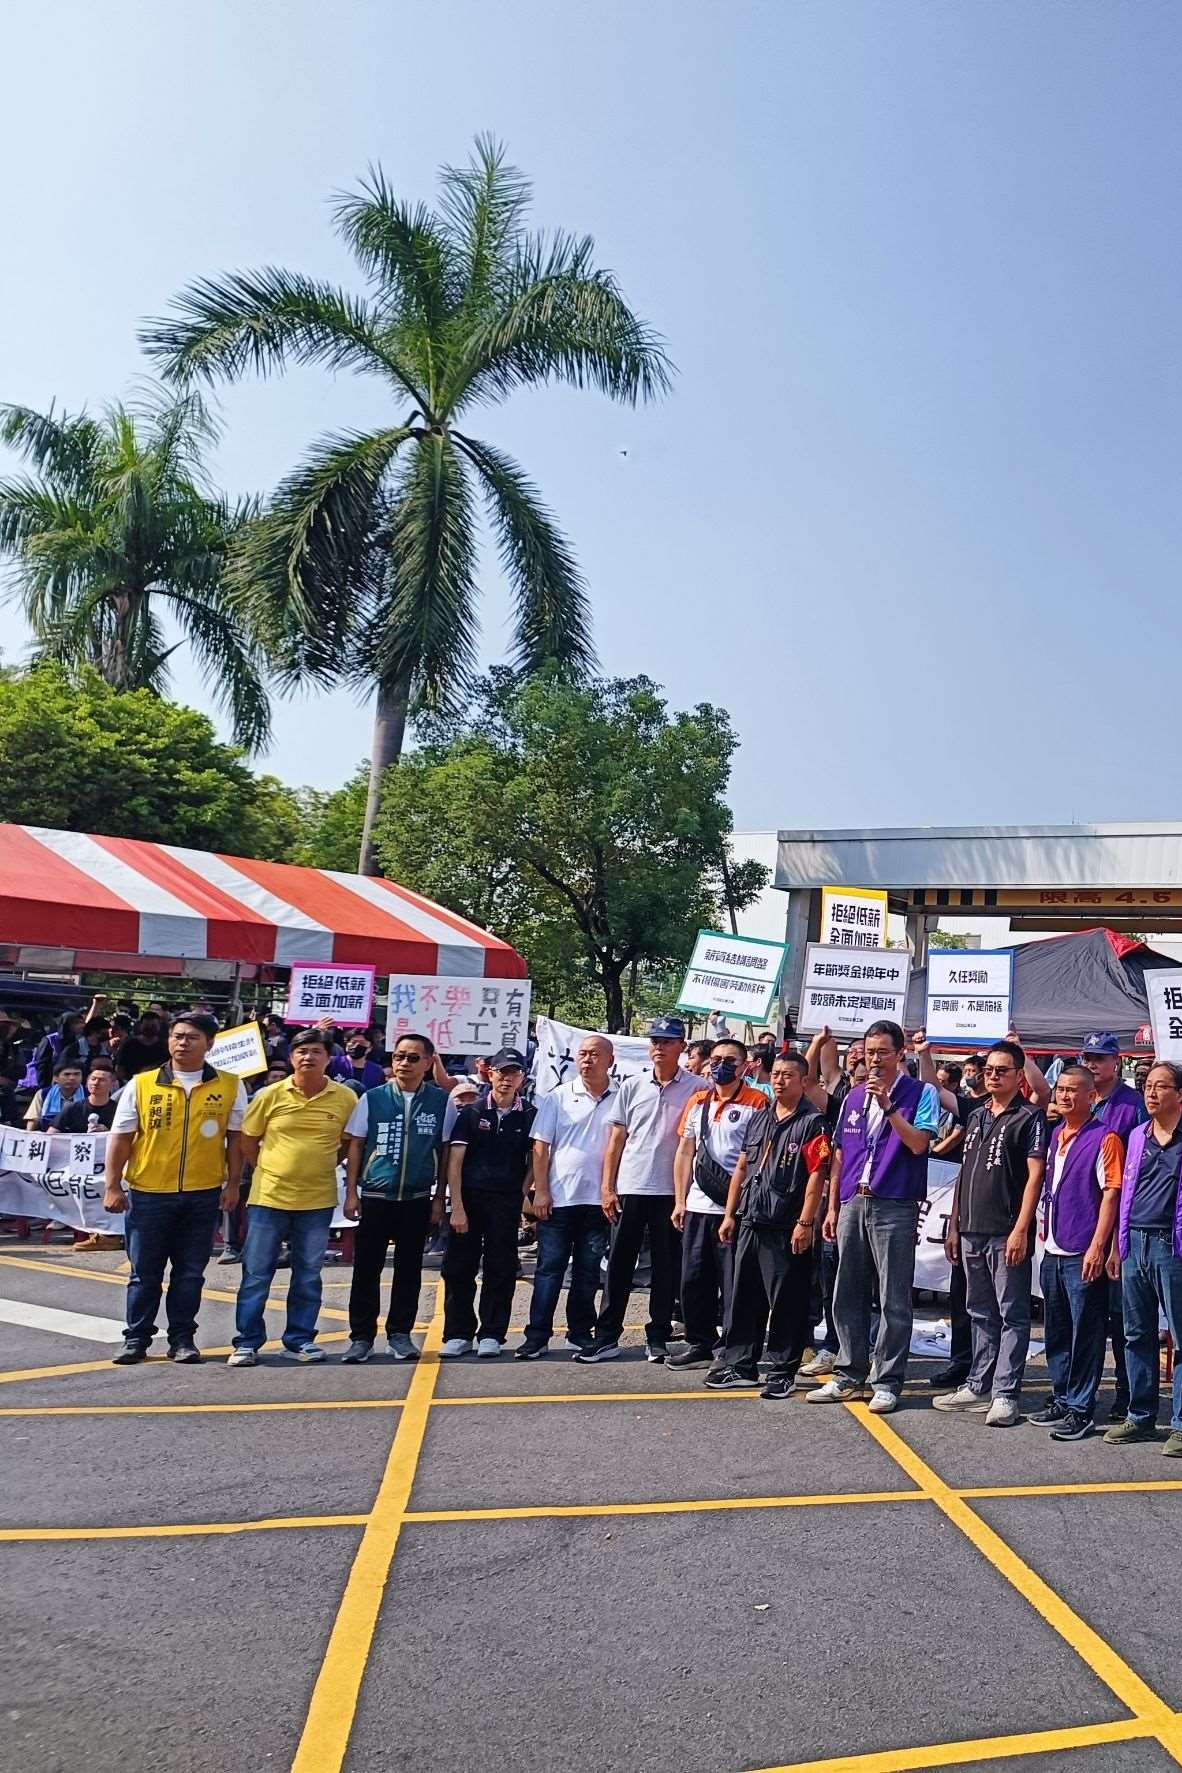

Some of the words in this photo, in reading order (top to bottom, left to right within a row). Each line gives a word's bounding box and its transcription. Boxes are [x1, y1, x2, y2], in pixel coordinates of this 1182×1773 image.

[831, 903, 881, 928] 拒絕低薪
[829, 927, 880, 947] 全面加薪
[813, 962, 900, 981] 年節獎金換年中
[300, 974, 368, 991] 拒絕低薪
[299, 992, 365, 1010] 全面加薪
[391, 983, 526, 1018] 我不要只有
